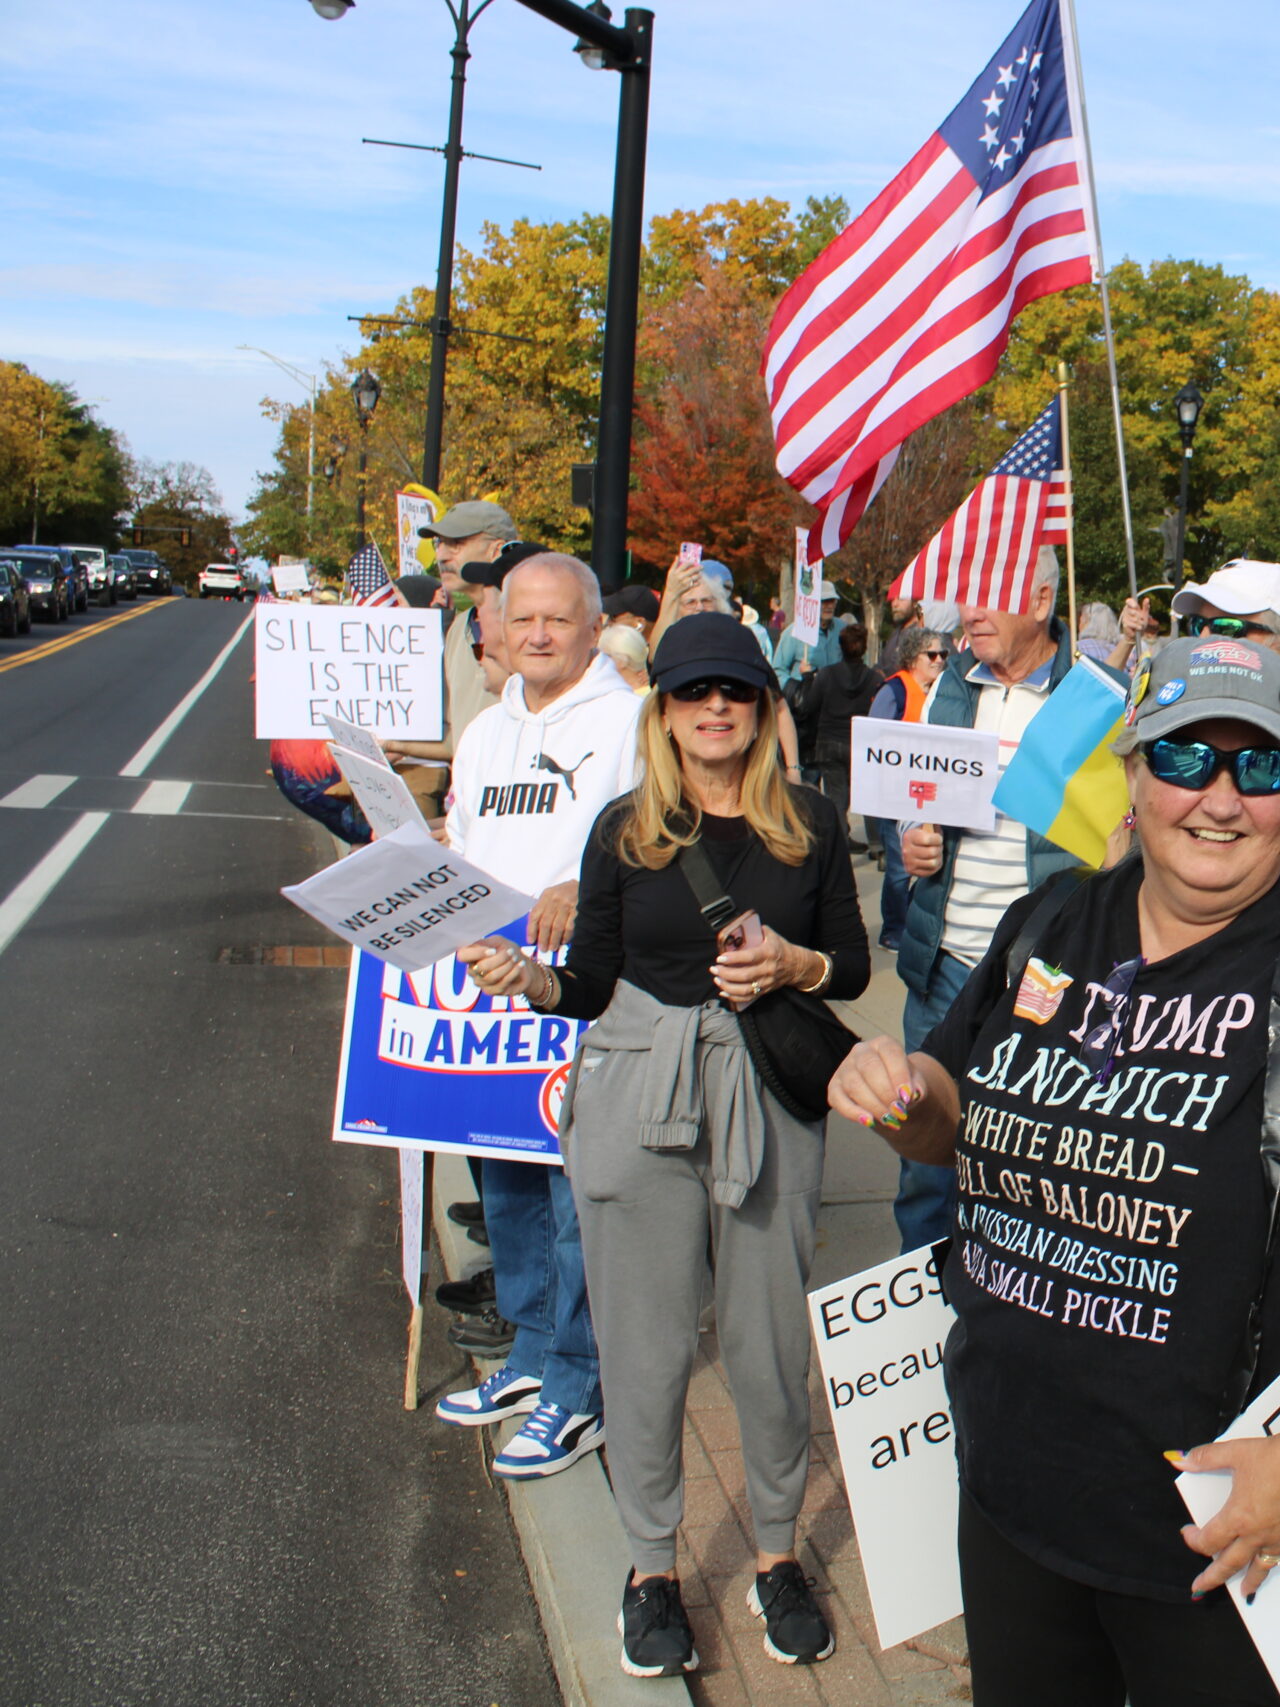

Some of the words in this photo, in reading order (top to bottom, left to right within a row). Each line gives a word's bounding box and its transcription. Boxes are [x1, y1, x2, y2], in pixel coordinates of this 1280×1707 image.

[265, 619, 426, 654] SILENCE
[310, 661, 340, 692] IS
[352, 662, 413, 692] THE
[1189, 666, 1206, 676] WE
[1207, 665, 1227, 674] ARE
[1229, 666, 1248, 677] NOT
[310, 698, 414, 727] ENEMY
[866, 746, 902, 767] NO
[908, 752, 984, 778] KINGS
[479, 782, 559, 817] PUMA
[338, 910, 378, 932] WE
[372, 886, 419, 917] CAN
[413, 863, 461, 893] NOT
[368, 929, 398, 952] BE
[394, 882, 493, 942] SILENCED
[388, 1018, 414, 1059] in
[967, 1032, 1229, 1132] SANDWICH
[1053, 1124, 1166, 1183] BREAD
[1000, 1168, 1033, 1207] OF
[1039, 1178, 1193, 1249] BALONEY
[1048, 1235, 1179, 1296] DRESSING
[987, 1259, 1054, 1318] SMALL
[1062, 1288, 1171, 1344] PICKLE
[870, 1409, 951, 1470] are
